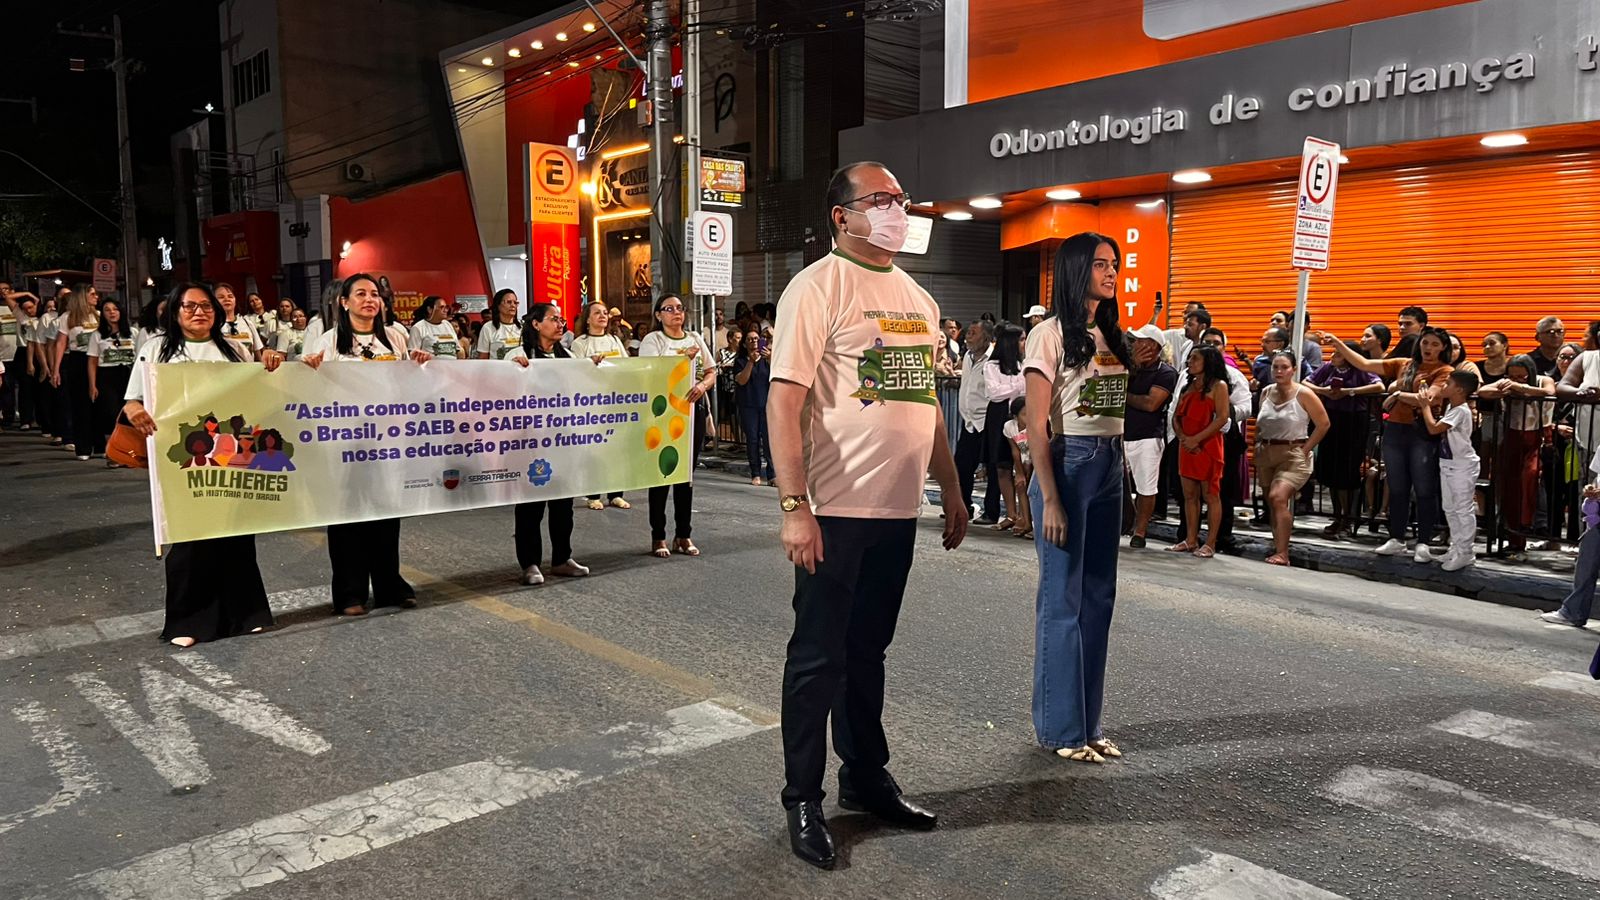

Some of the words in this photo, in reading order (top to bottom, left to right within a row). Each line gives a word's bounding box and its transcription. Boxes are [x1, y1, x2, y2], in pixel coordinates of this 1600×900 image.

[989, 106, 1185, 158] Odontologia
[1209, 94, 1260, 125] de
[1287, 52, 1535, 111] confiança
[1576, 35, 1598, 71] t
[546, 159, 564, 186] E
[1313, 163, 1325, 191] E
[708, 224, 718, 243] E
[1299, 220, 1312, 229] ZONA
[1315, 222, 1328, 231] AZUL
[546, 245, 562, 300] Ultra
[882, 351, 925, 370] SAEB
[364, 402, 421, 416] como
[424, 402, 436, 414] a
[440, 393, 571, 415] independência
[574, 392, 648, 407] fortaleceu
[1095, 393, 1127, 408] SAEP
[299, 430, 313, 443] o
[317, 423, 383, 442] Brasil,
[387, 425, 400, 438] o
[404, 420, 455, 437] SAEB
[458, 421, 470, 434] e
[474, 421, 485, 433] o
[489, 415, 543, 432] SAEPE
[546, 412, 628, 428] fortalecem
[630, 411, 639, 422] a
[342, 447, 400, 463] nossa
[405, 440, 495, 458] educação
[499, 437, 538, 454] para
[541, 436, 551, 448] o
[187, 469, 288, 492] MULHERES
[467, 473, 492, 483] SERRA
[193, 490, 204, 498] NA
[205, 489, 241, 499] HISTÓRIA
[243, 492, 254, 500] DO
[255, 493, 282, 502] BRASIL
